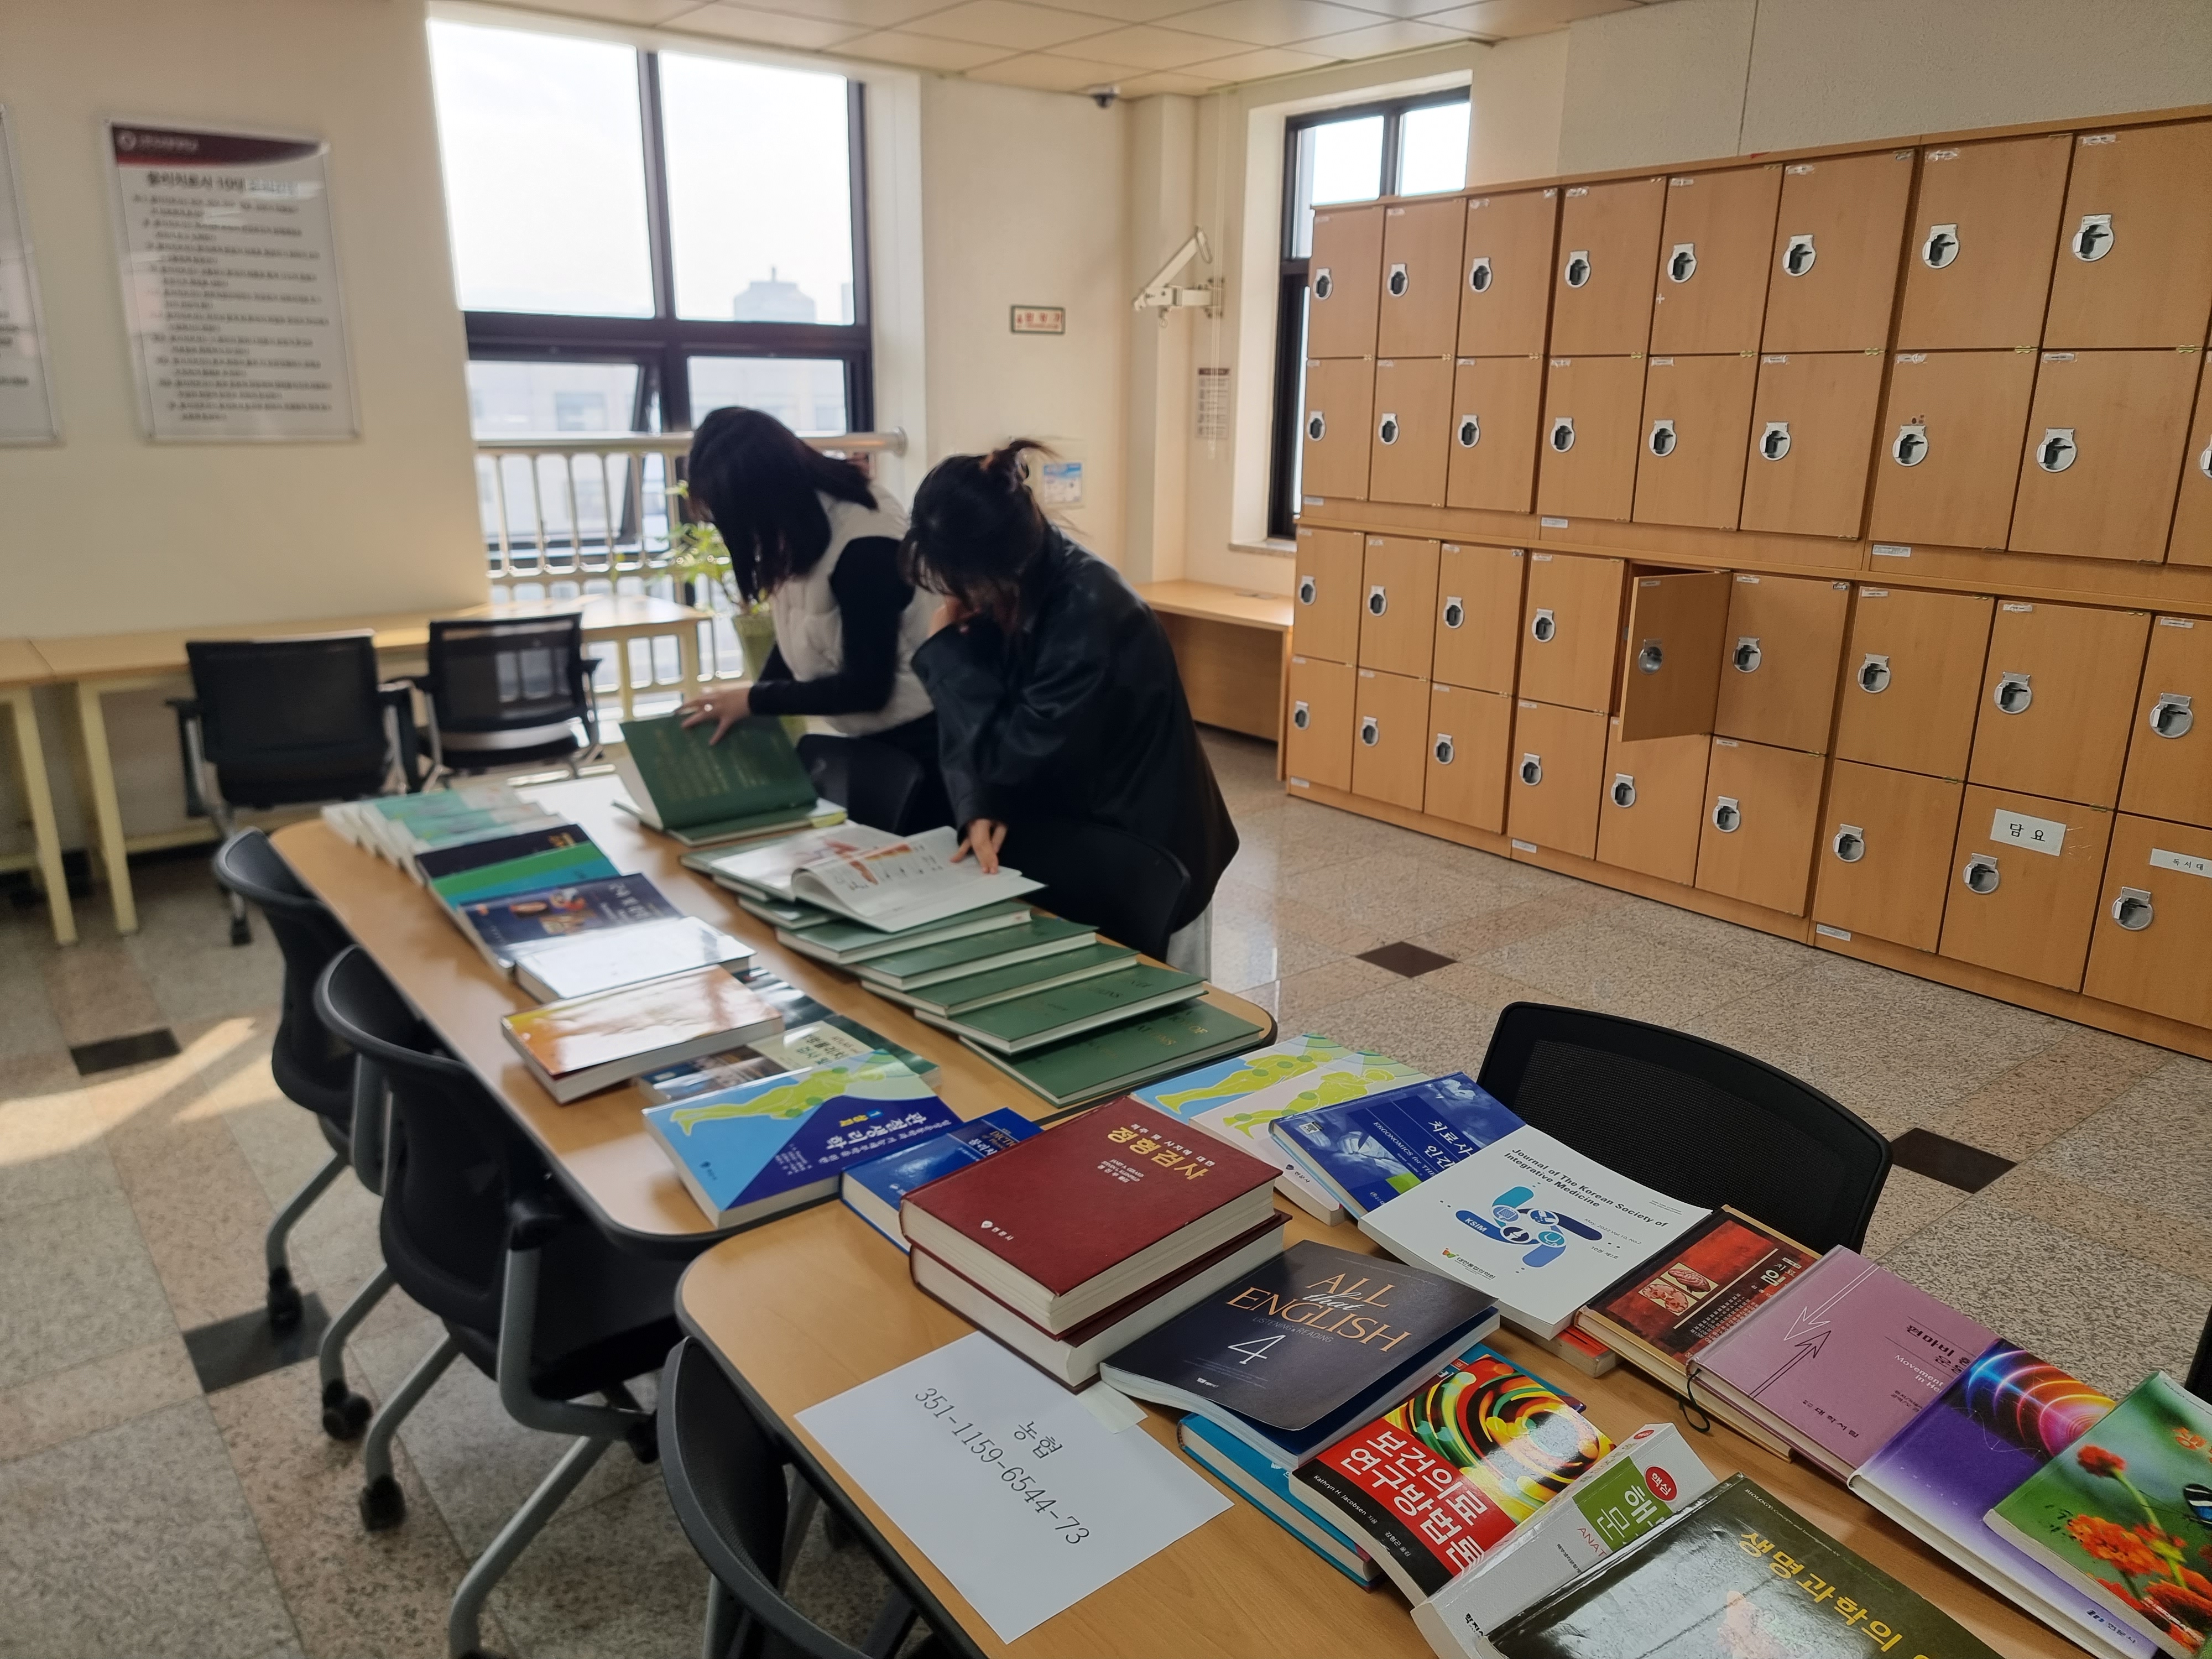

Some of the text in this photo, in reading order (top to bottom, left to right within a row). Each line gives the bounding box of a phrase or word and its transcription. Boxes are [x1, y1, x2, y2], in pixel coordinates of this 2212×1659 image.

[826, 1112, 927, 1150] 관절생리학
[1373, 1121, 1413, 1156] ERGONOMICS
[1107, 1126, 1209, 1180] 정형검사
[1504, 1152, 1600, 1208] Integrative Medicine
[1512, 1149, 1549, 1170] Journal
[1548, 1167, 1561, 1177] of
[1559, 1175, 1578, 1187] The
[1578, 1184, 1614, 1206] Korean
[1615, 1203, 1655, 1224] Society
[1465, 1218, 1488, 1232] KSIM
[1302, 1292, 1365, 1311] that
[1305, 1272, 1396, 1308] ALL
[1226, 1287, 1412, 1353] ENGLISH
[1253, 1317, 1292, 1331] LISTENING
[1296, 1328, 1334, 1343] READING
[1228, 1334, 1287, 1365] 4
[1906, 1324, 1955, 1357] 편마비
[1895, 1354, 1944, 1387] Movement
[1013, 1421, 1063, 1459] 농협
[915, 1387, 1090, 1545] 351-1159-6544-73
[1366, 1431, 1489, 1526] 보건의료
[1651, 1472, 1672, 1496] 핵심
[1313, 1475, 1335, 1491] Kathryn
[1340, 1494, 1367, 1516] Jacobsen
[1340, 1448, 1485, 1573] 연구방법론
[1739, 1532, 1903, 1652] 생명과학의
